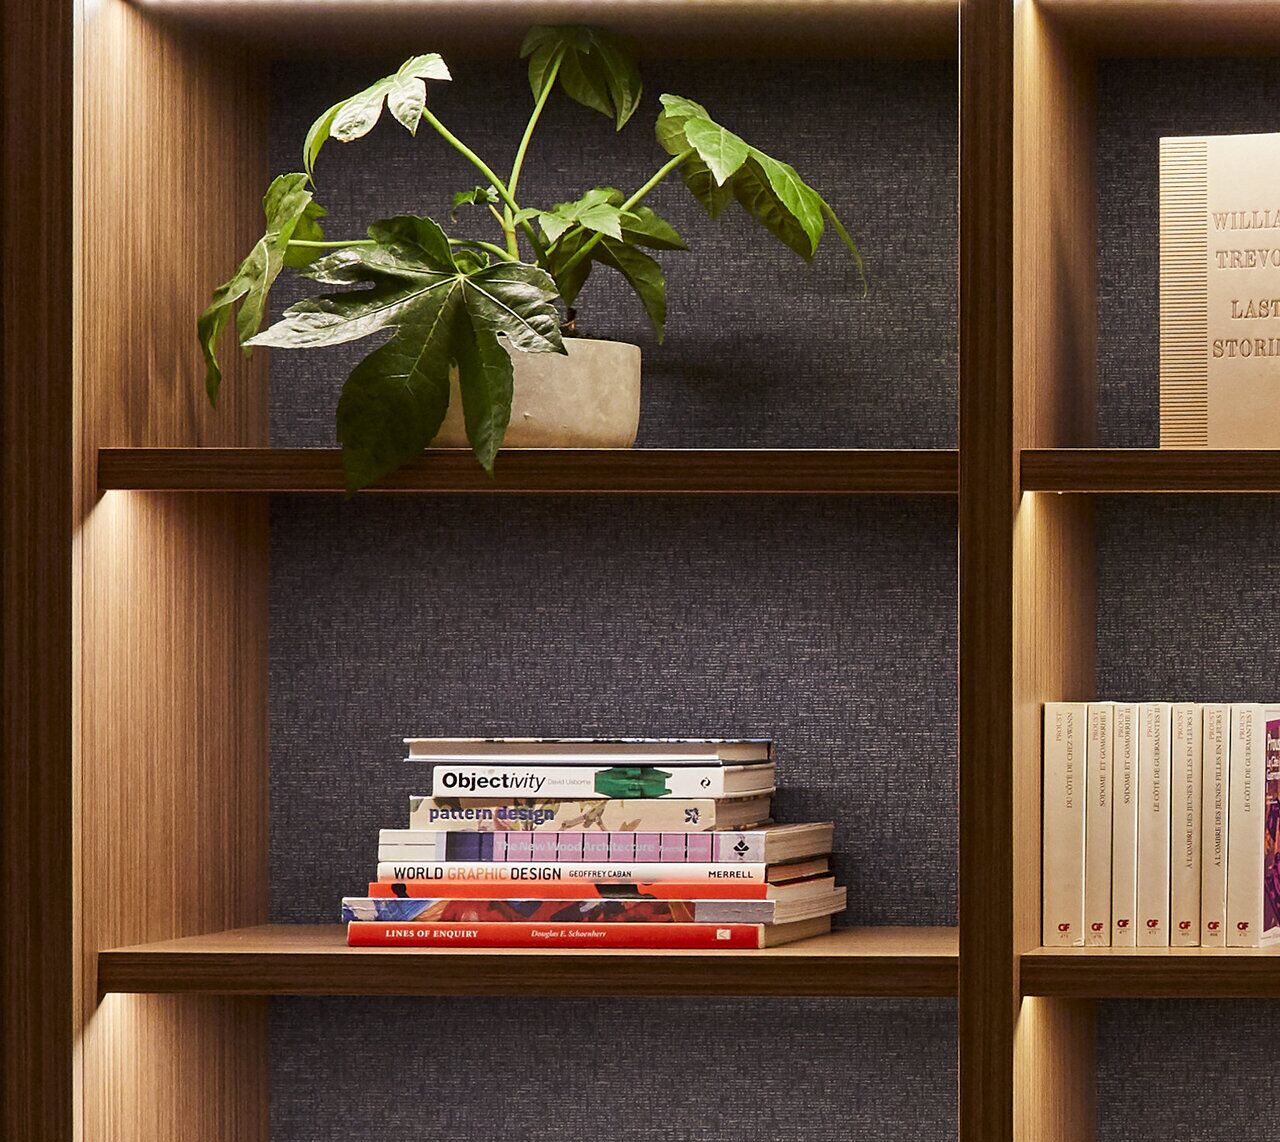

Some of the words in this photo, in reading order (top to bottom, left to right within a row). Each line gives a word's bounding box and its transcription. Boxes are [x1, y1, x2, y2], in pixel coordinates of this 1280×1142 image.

[1153, 714, 1161, 767] GUERMANTES
[1186, 746, 1193, 757] EN
[1215, 744, 1222, 755] EN
[1066, 762, 1073, 773] DE
[1099, 762, 1106, 771] ET
[1124, 760, 1131, 771] ET
[1153, 769, 1160, 779] DE
[1244, 770, 1252, 779] DE
[442, 772, 546, 792] Objectivity
[1186, 784, 1194, 811] JEUNES
[1214, 783, 1223, 811] JEUNES
[1153, 804, 1160, 812] LE
[428, 806, 493, 823] pattern
[497, 805, 555, 825] design
[498, 841, 517, 851] The
[518, 841, 545, 851] New
[546, 841, 581, 851] Wood
[394, 866, 443, 880] WORLD
[448, 866, 507, 880] GRAPHIC
[510, 866, 562, 881] DESIGN
[568, 870, 607, 878] GEOFFREY
[607, 870, 632, 878] CABAN
[708, 871, 754, 879] MERRELL
[1057, 923, 1070, 932] GF
[1091, 922, 1104, 931] GF
[1116, 919, 1129, 928] GF
[1146, 919, 1159, 928] GF
[1178, 921, 1191, 930] GF
[1207, 921, 1220, 930] GF
[1236, 921, 1249, 931] GF
[385, 929, 415, 938] LINES
[416, 929, 430, 938] OF
[433, 929, 479, 940] ENQUIRY
[530, 929, 559, 939] Douglas
